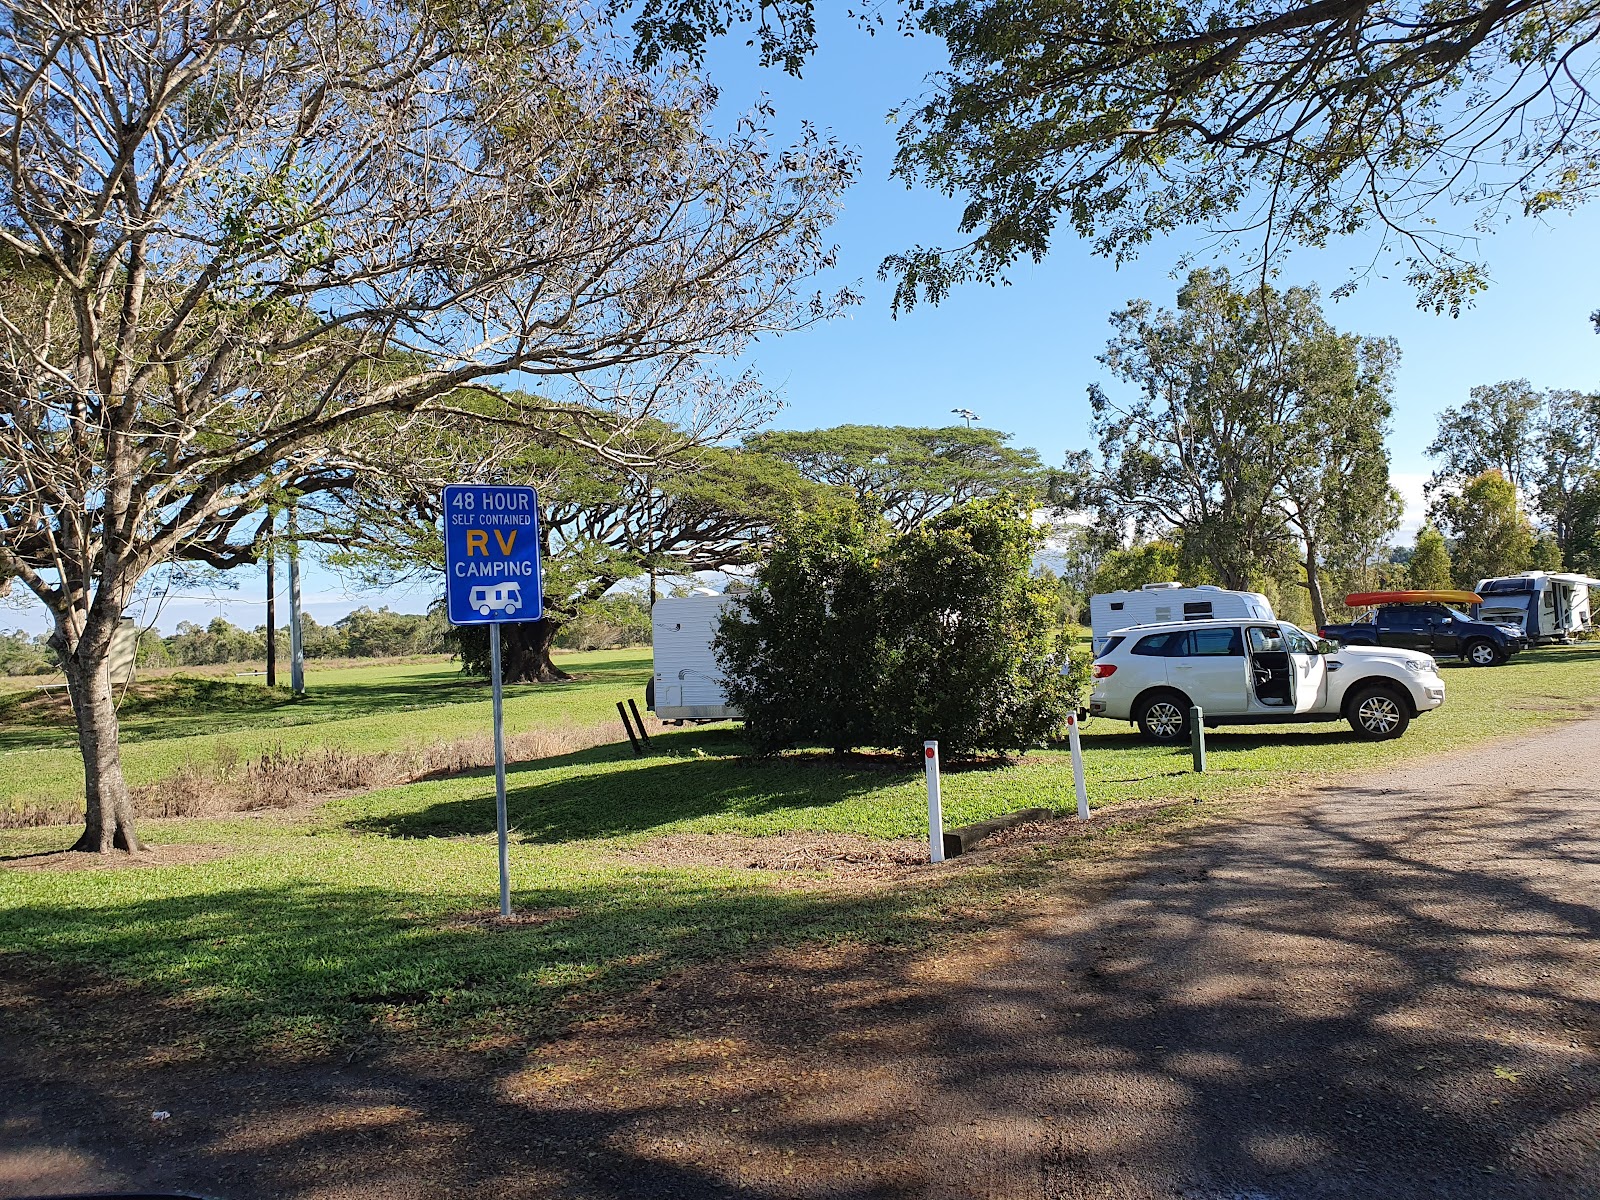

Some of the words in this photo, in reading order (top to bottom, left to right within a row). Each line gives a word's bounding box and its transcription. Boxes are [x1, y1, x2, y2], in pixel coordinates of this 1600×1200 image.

[452, 492, 475, 510] 48
[483, 492, 529, 510] HOUR
[452, 514, 475, 525] SELF
[479, 514, 531, 525] CONTAINED
[466, 529, 517, 556] RV
[455, 561, 532, 577] CAMPING
